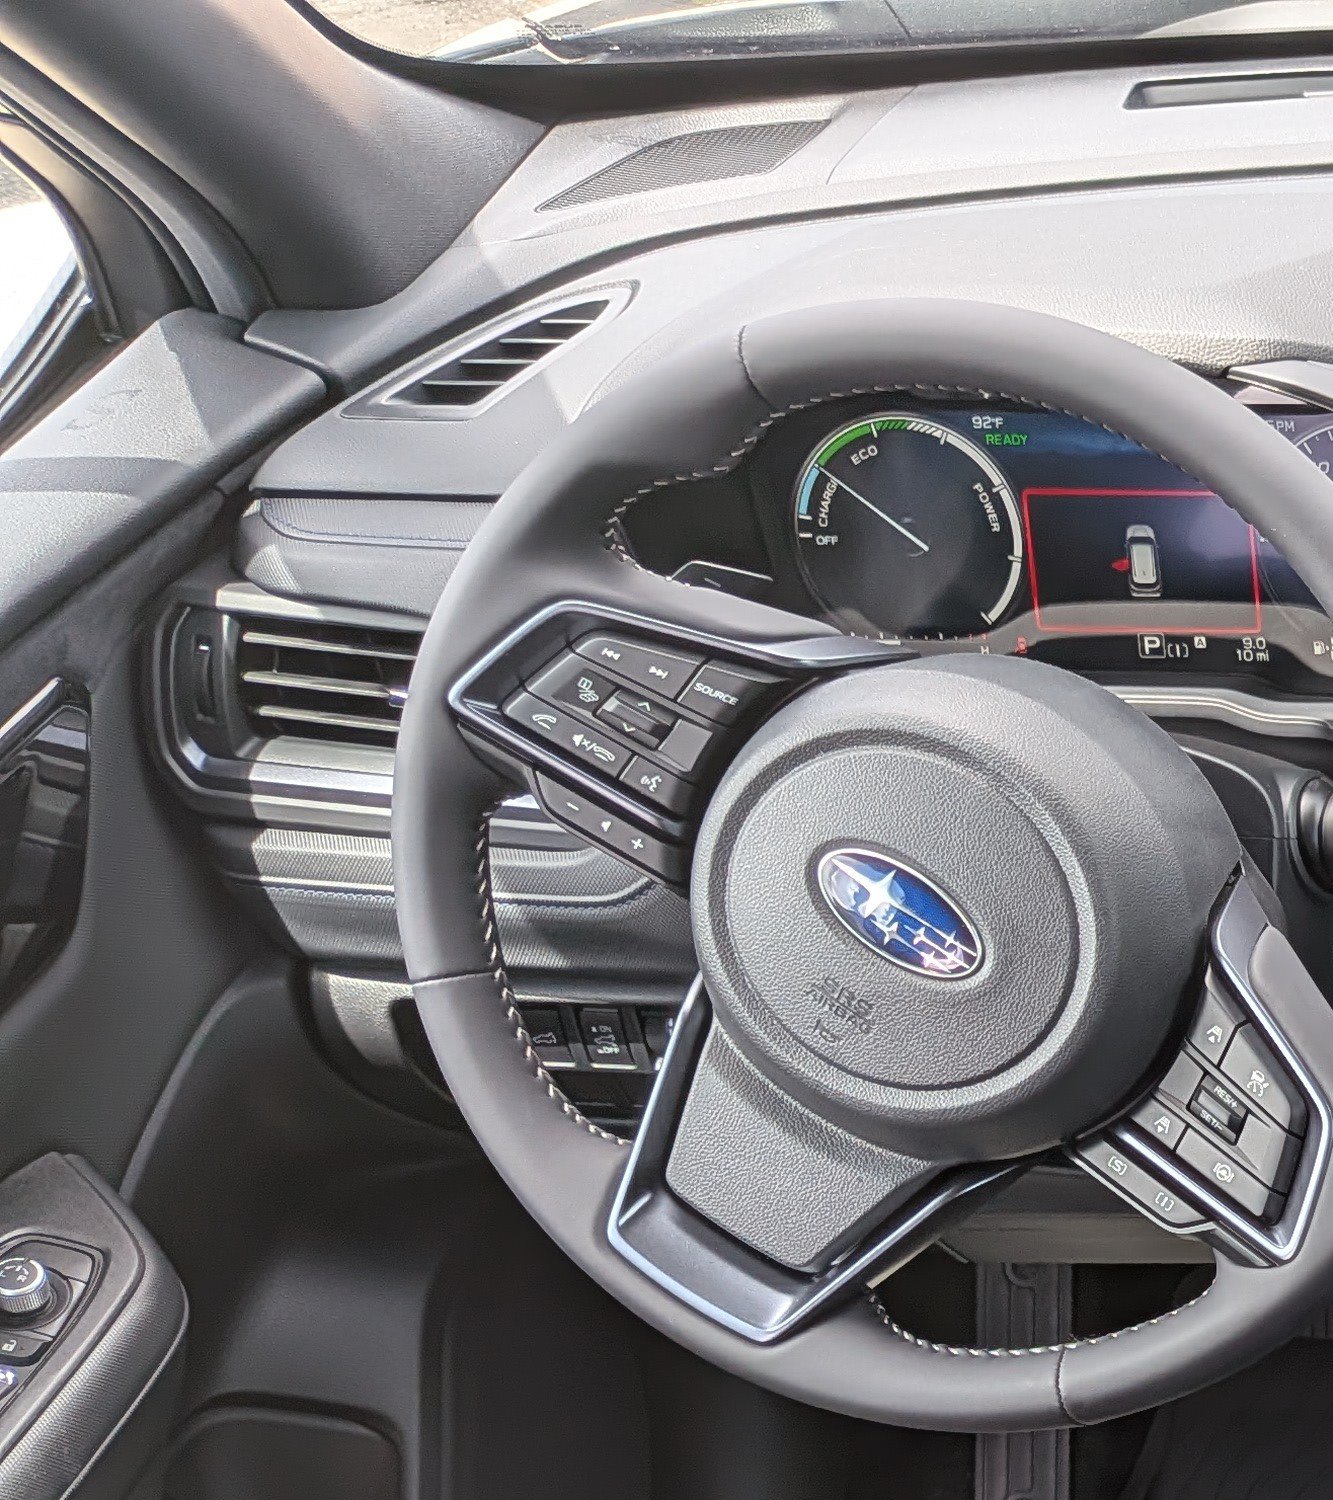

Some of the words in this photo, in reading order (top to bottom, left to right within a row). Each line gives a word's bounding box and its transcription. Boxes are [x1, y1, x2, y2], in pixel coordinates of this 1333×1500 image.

[985, 434, 1027, 445] READY
[850, 445, 878, 465] ECO
[972, 482, 1000, 533] POWER
[815, 535, 838, 546] OFF
[1143, 636, 1160, 655] P
[1242, 637, 1266, 649] 9.0
[981, 645, 989, 655] H
[1236, 649, 1253, 662] 10
[1256, 650, 1270, 662] mi
[694, 682, 739, 706] SOURCE
